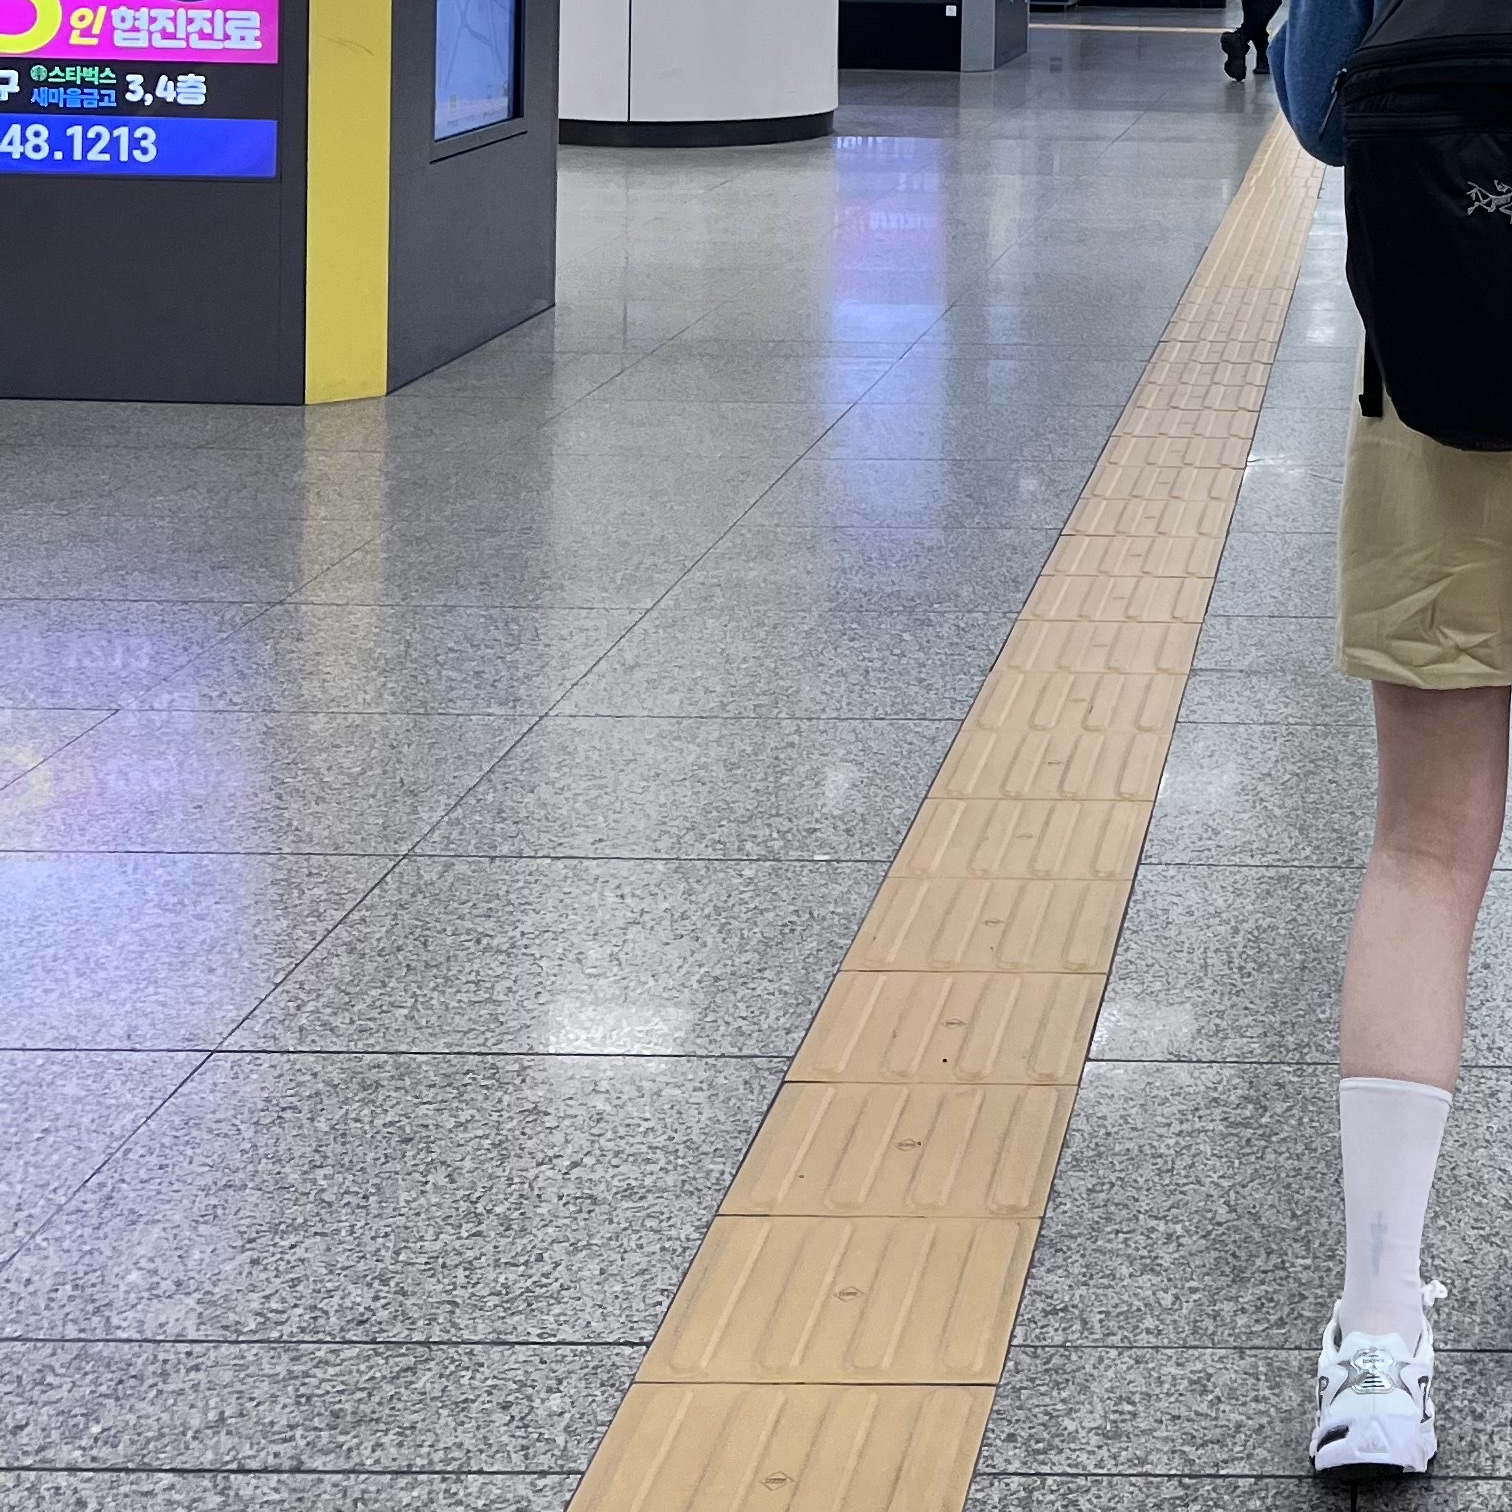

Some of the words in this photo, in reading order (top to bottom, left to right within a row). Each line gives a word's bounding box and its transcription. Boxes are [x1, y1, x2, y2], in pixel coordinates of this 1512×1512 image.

[111, 5, 263, 50] 협진진료
[47, 65, 117, 86] 스타벅스
[125, 73, 207, 107] 3,4층
[31, 87, 118, 109] 새마을금고
[0, 123, 157, 163] 48.1213
